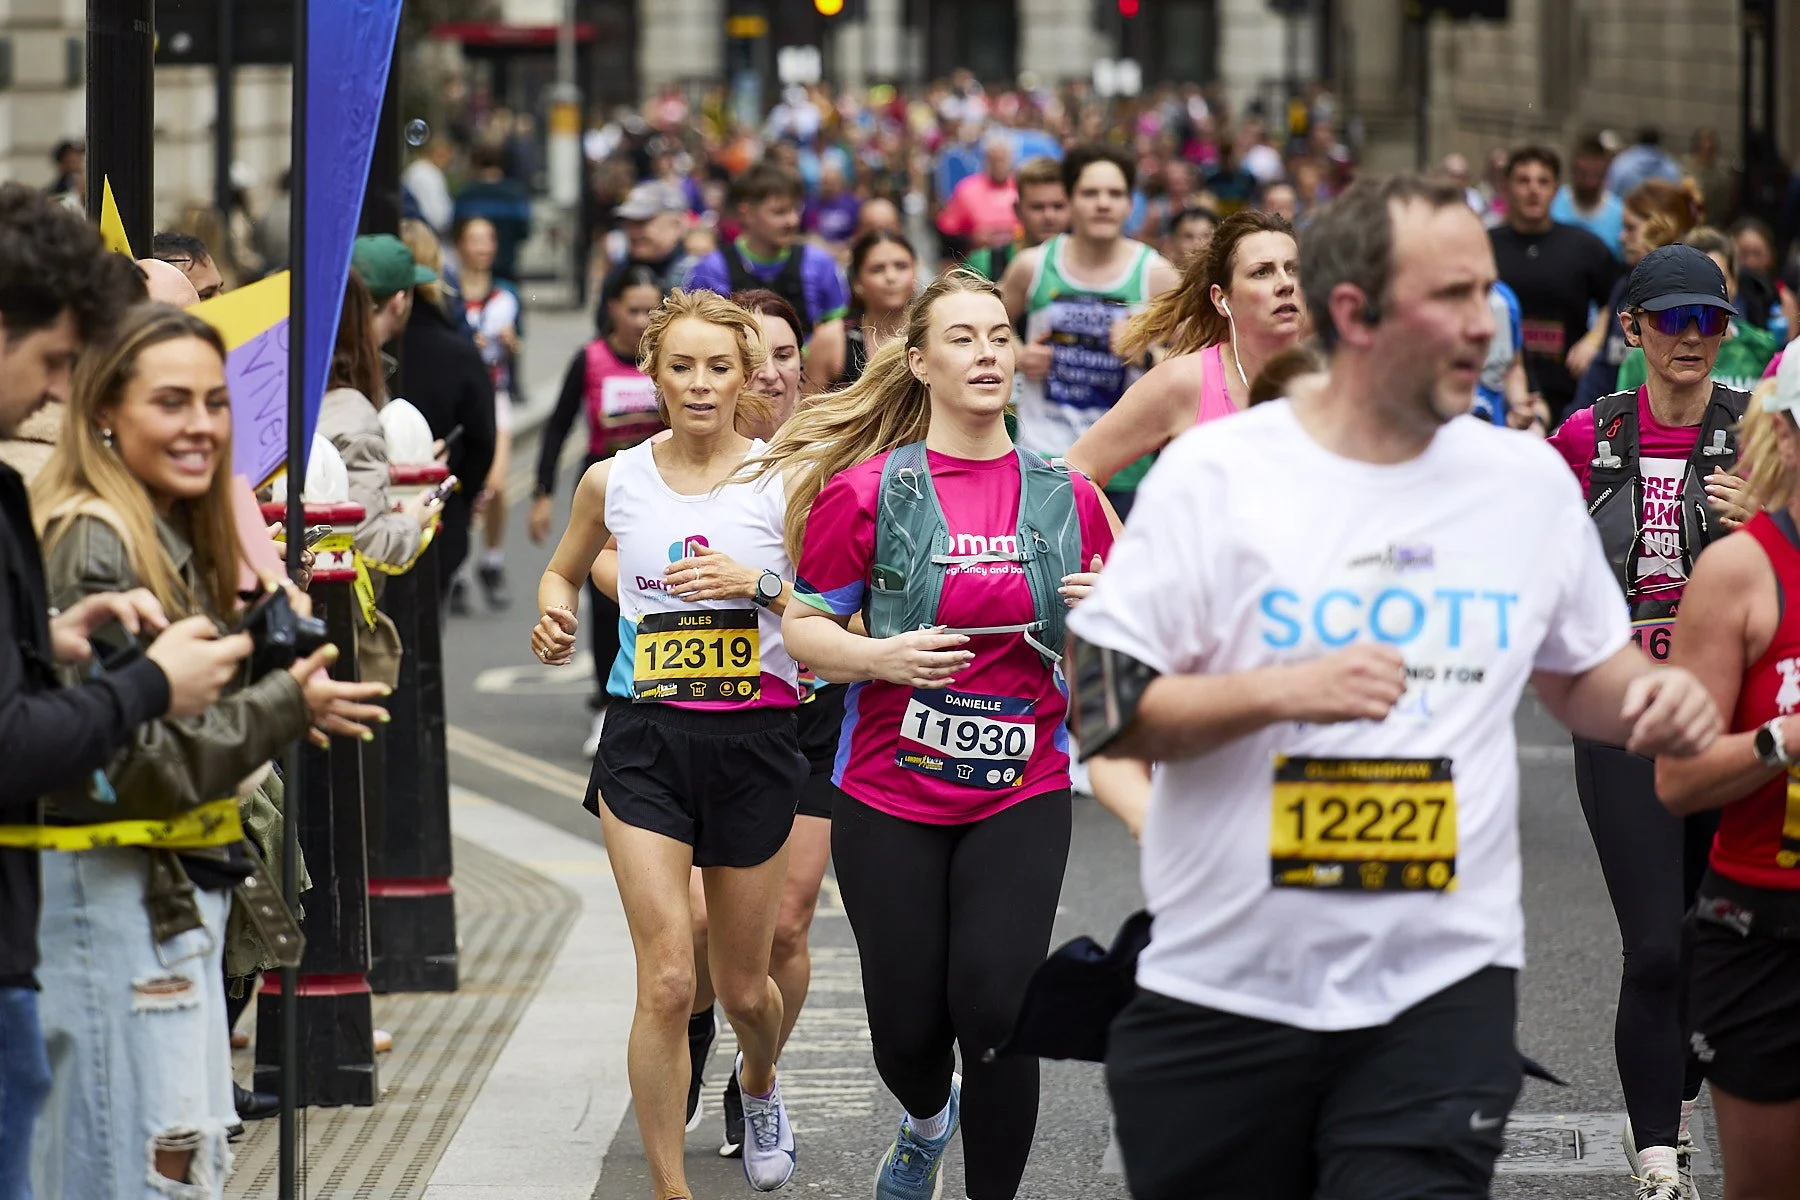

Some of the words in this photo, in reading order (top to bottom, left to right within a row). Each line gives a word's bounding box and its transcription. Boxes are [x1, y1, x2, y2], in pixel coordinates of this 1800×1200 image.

[990, 565, 1008, 574] and
[678, 616, 712, 626] JULES
[1258, 587, 1519, 650] SCOTT
[644, 636, 752, 671] 12319
[945, 694, 1002, 711] DANIELLE
[915, 709, 1027, 757] 11930
[1287, 797, 1446, 842] 12227
